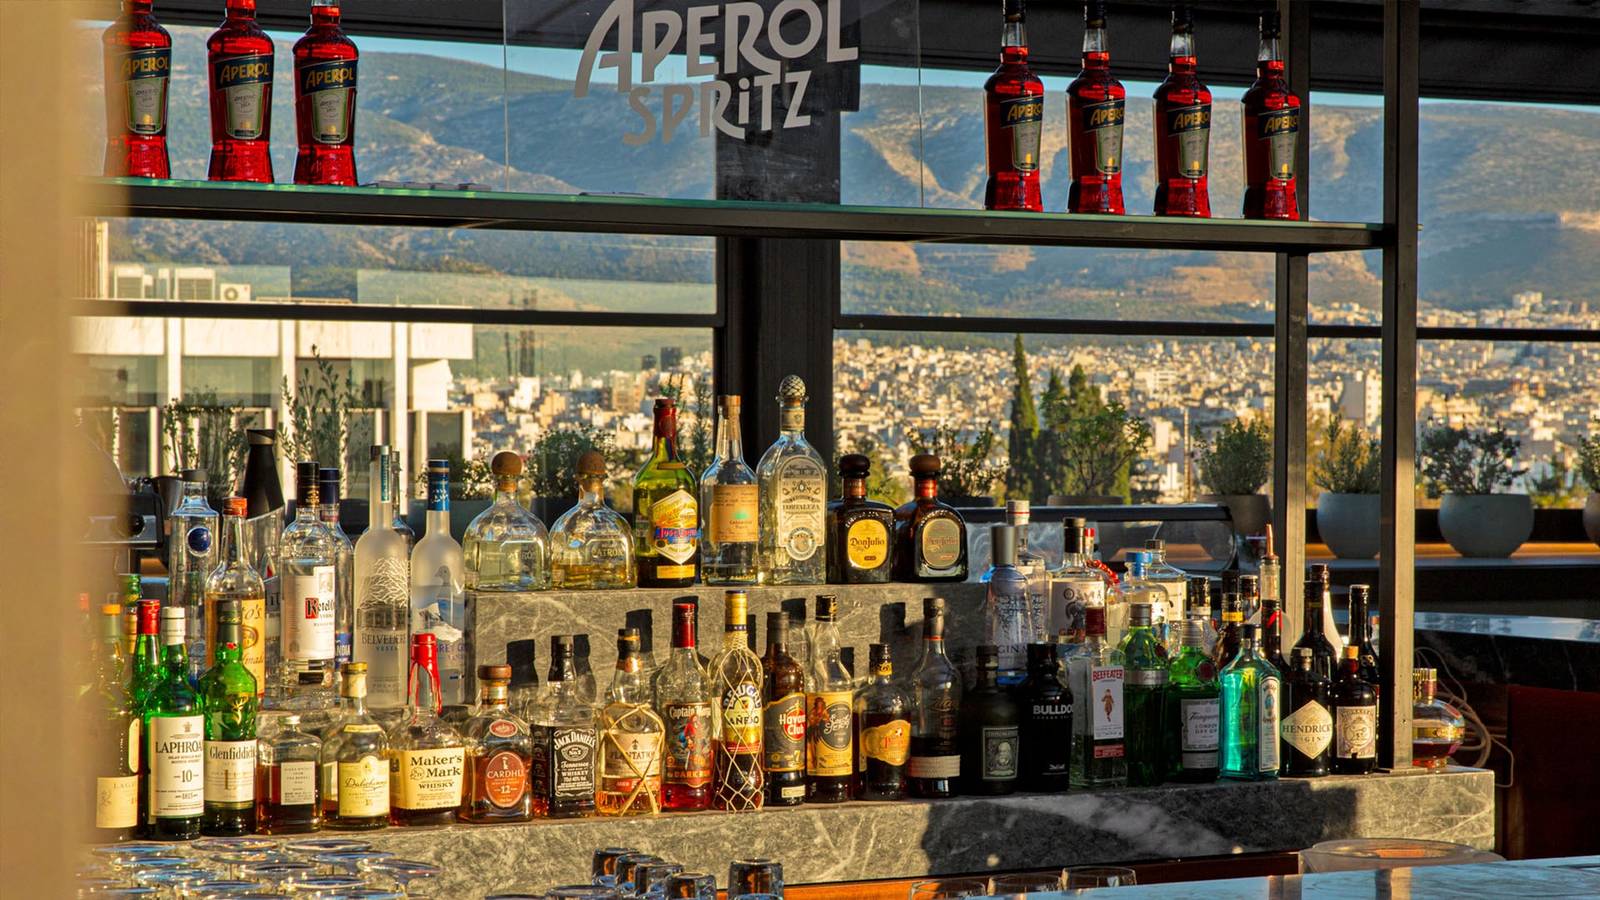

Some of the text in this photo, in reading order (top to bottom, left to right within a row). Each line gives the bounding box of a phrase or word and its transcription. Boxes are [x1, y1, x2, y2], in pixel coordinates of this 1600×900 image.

[574, 0, 859, 98] APEROL
[220, 63, 270, 84] APEROL
[305, 68, 354, 89] APEROL
[1092, 669, 1123, 681] BEEFEATER
[410, 755, 463, 766] Maker's
[181, 770, 193, 783] 10
[426, 766, 461, 778] Mark
[500, 785, 511, 794] 12
